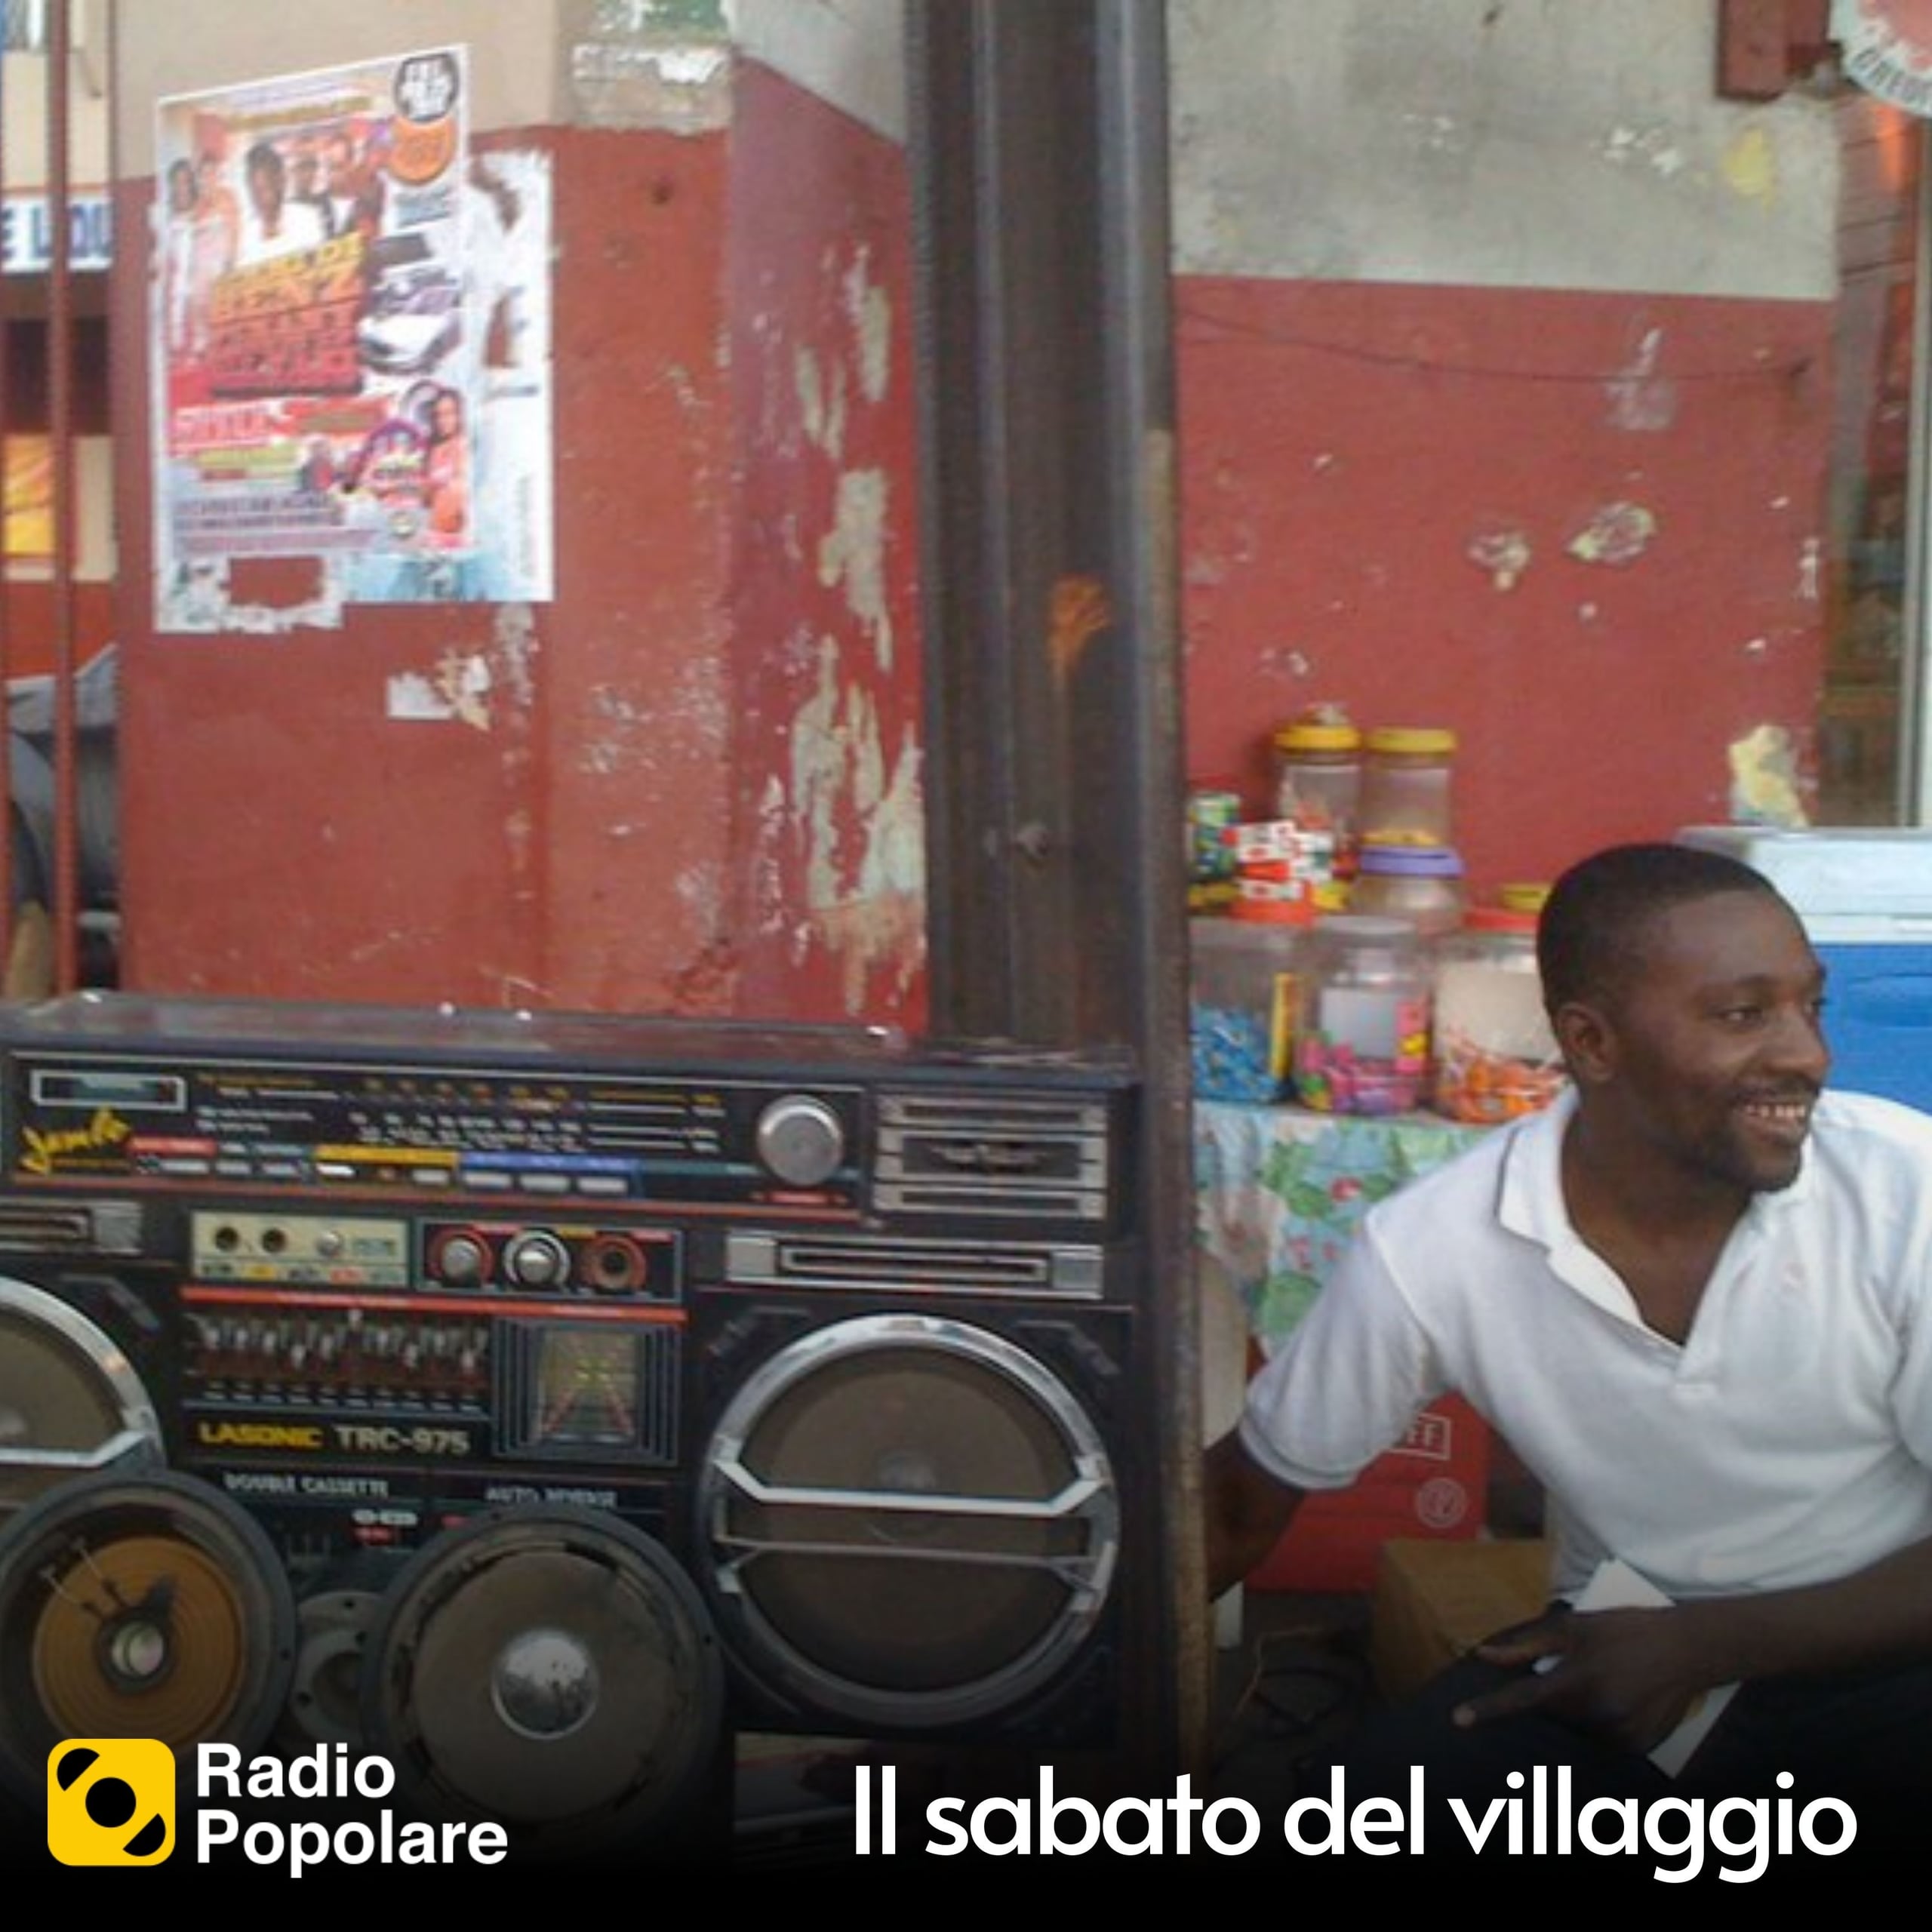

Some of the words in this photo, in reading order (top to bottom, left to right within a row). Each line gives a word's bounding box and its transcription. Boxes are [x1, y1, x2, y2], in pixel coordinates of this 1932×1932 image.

[198, 1422, 323, 1448] LASONIC
[333, 1425, 470, 1454] TRC-975
[301, 1475, 389, 1498] CASSETTE
